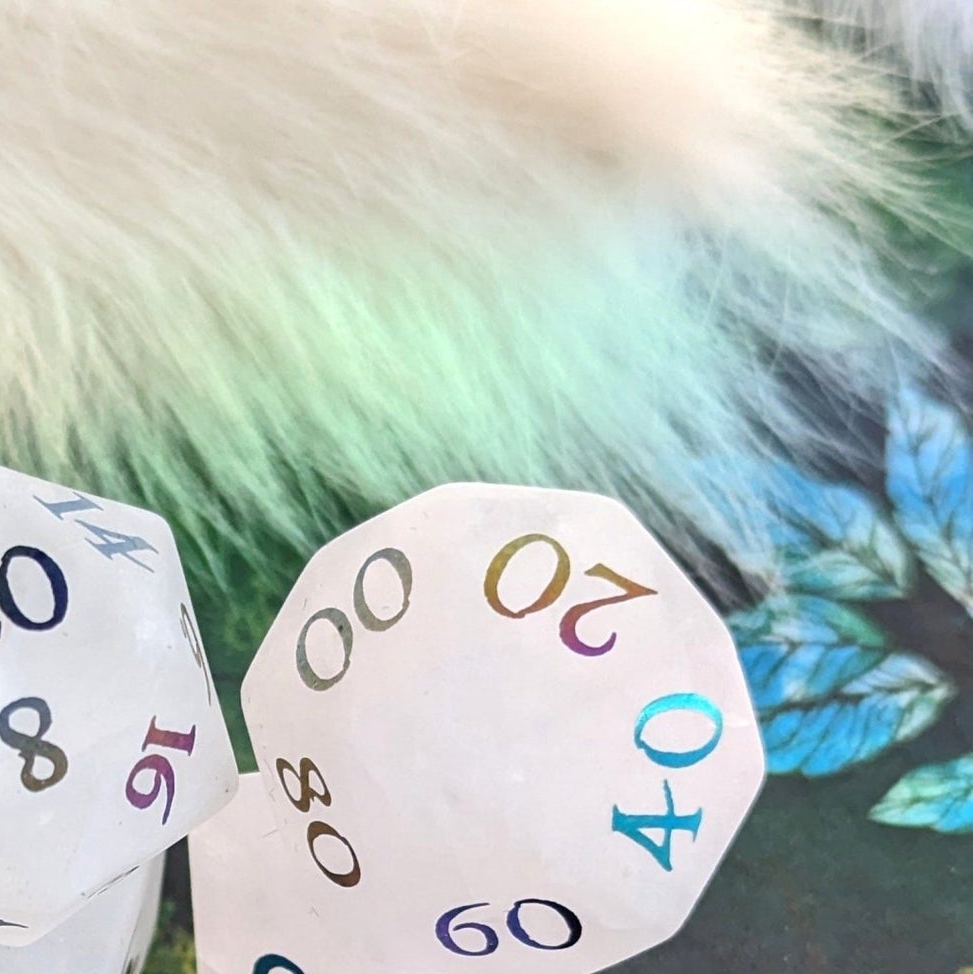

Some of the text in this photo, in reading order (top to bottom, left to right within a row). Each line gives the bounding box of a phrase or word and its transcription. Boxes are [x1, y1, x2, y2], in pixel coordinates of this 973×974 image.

[296, 547, 412, 691] 00
[484, 533, 658, 656] 20
[125, 716, 196, 825] 16
[276, 757, 361, 888] 80
[612, 692, 723, 871] 40
[435, 898, 583, 956] 60
